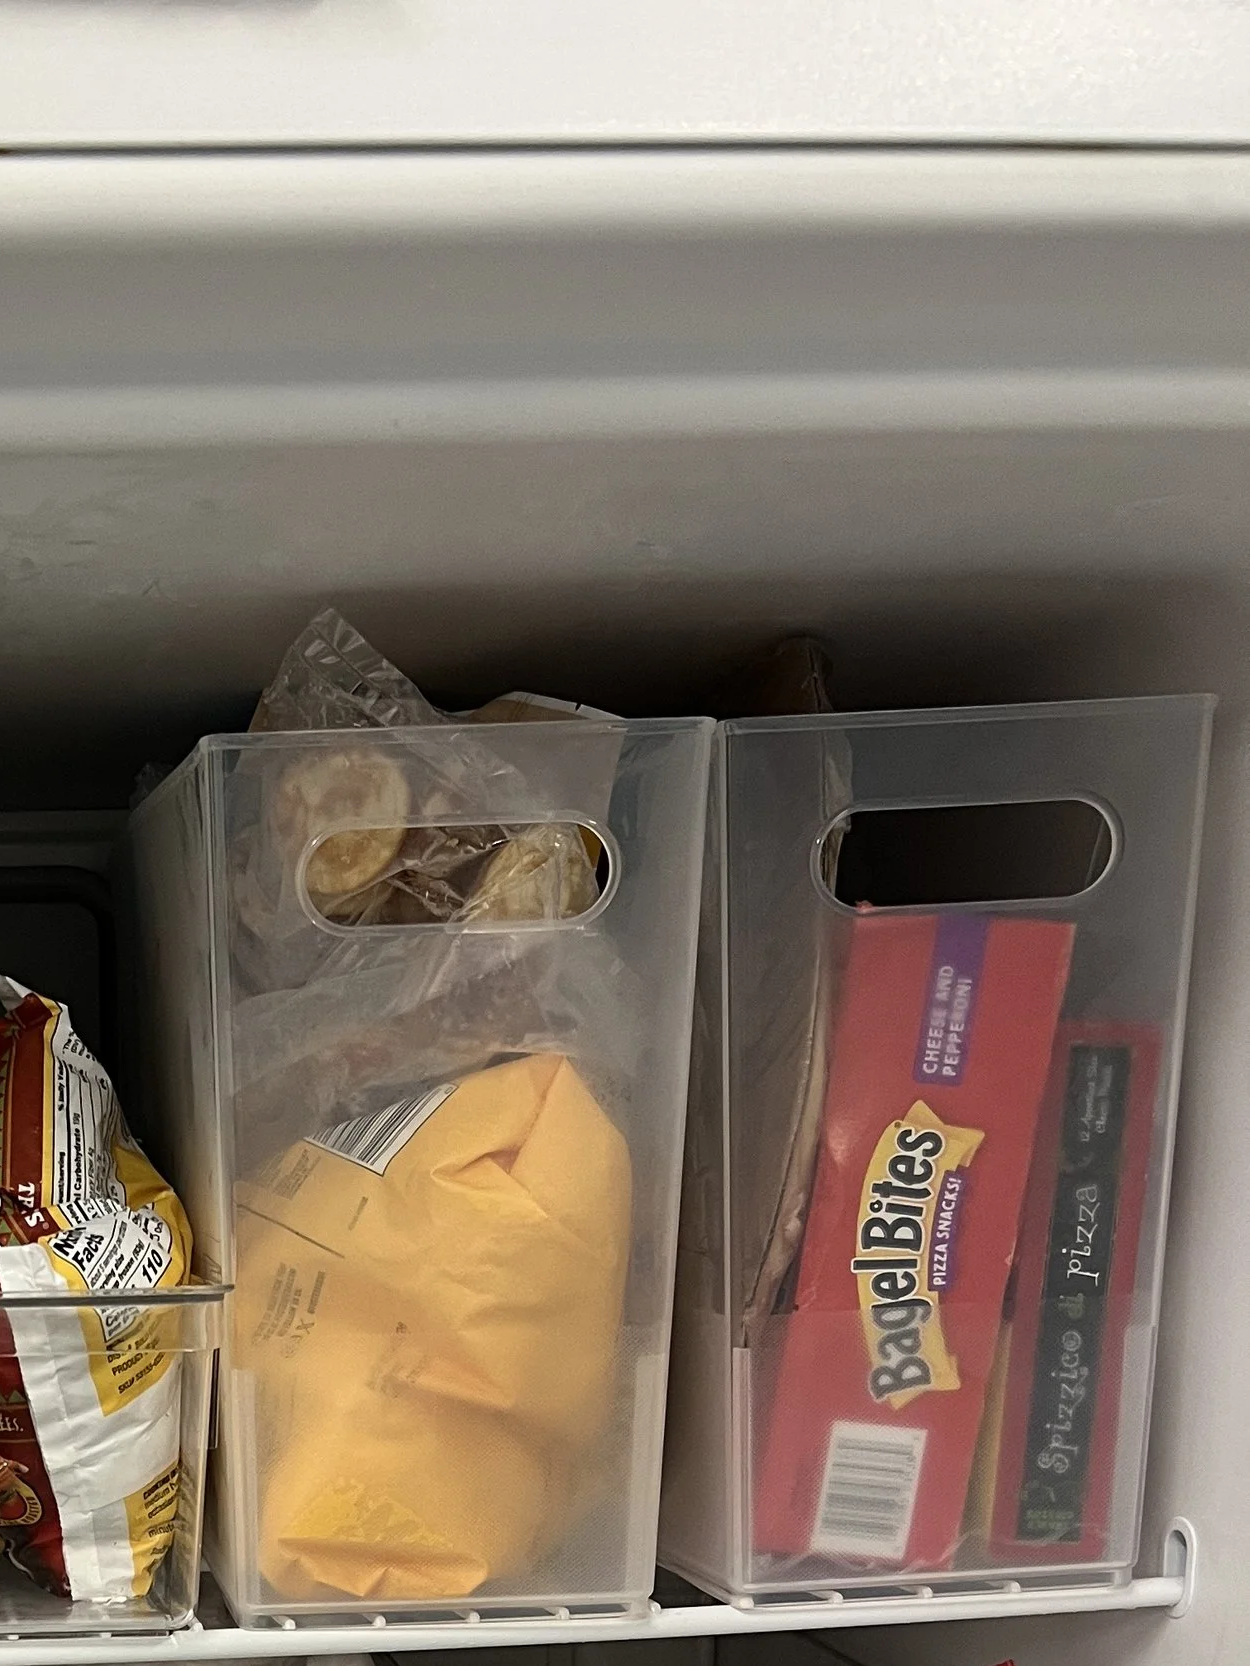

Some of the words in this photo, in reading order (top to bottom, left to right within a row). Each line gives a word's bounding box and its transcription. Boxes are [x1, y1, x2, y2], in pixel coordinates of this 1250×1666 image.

[934, 965, 954, 1001] AND
[922, 1008, 948, 1074] CHEESE
[942, 979, 973, 1077] PEPPERONI
[73, 1128, 82, 1190] Carbohydrate
[860, 1129, 943, 1251] Bites
[935, 1177, 962, 1240] SNACKS!
[1061, 1184, 1100, 1286] pizza
[71, 1233, 105, 1271] Facts
[142, 1249, 163, 1283] 110
[932, 1243, 949, 1286] PIZZA
[851, 1259, 932, 1400] Bagel
